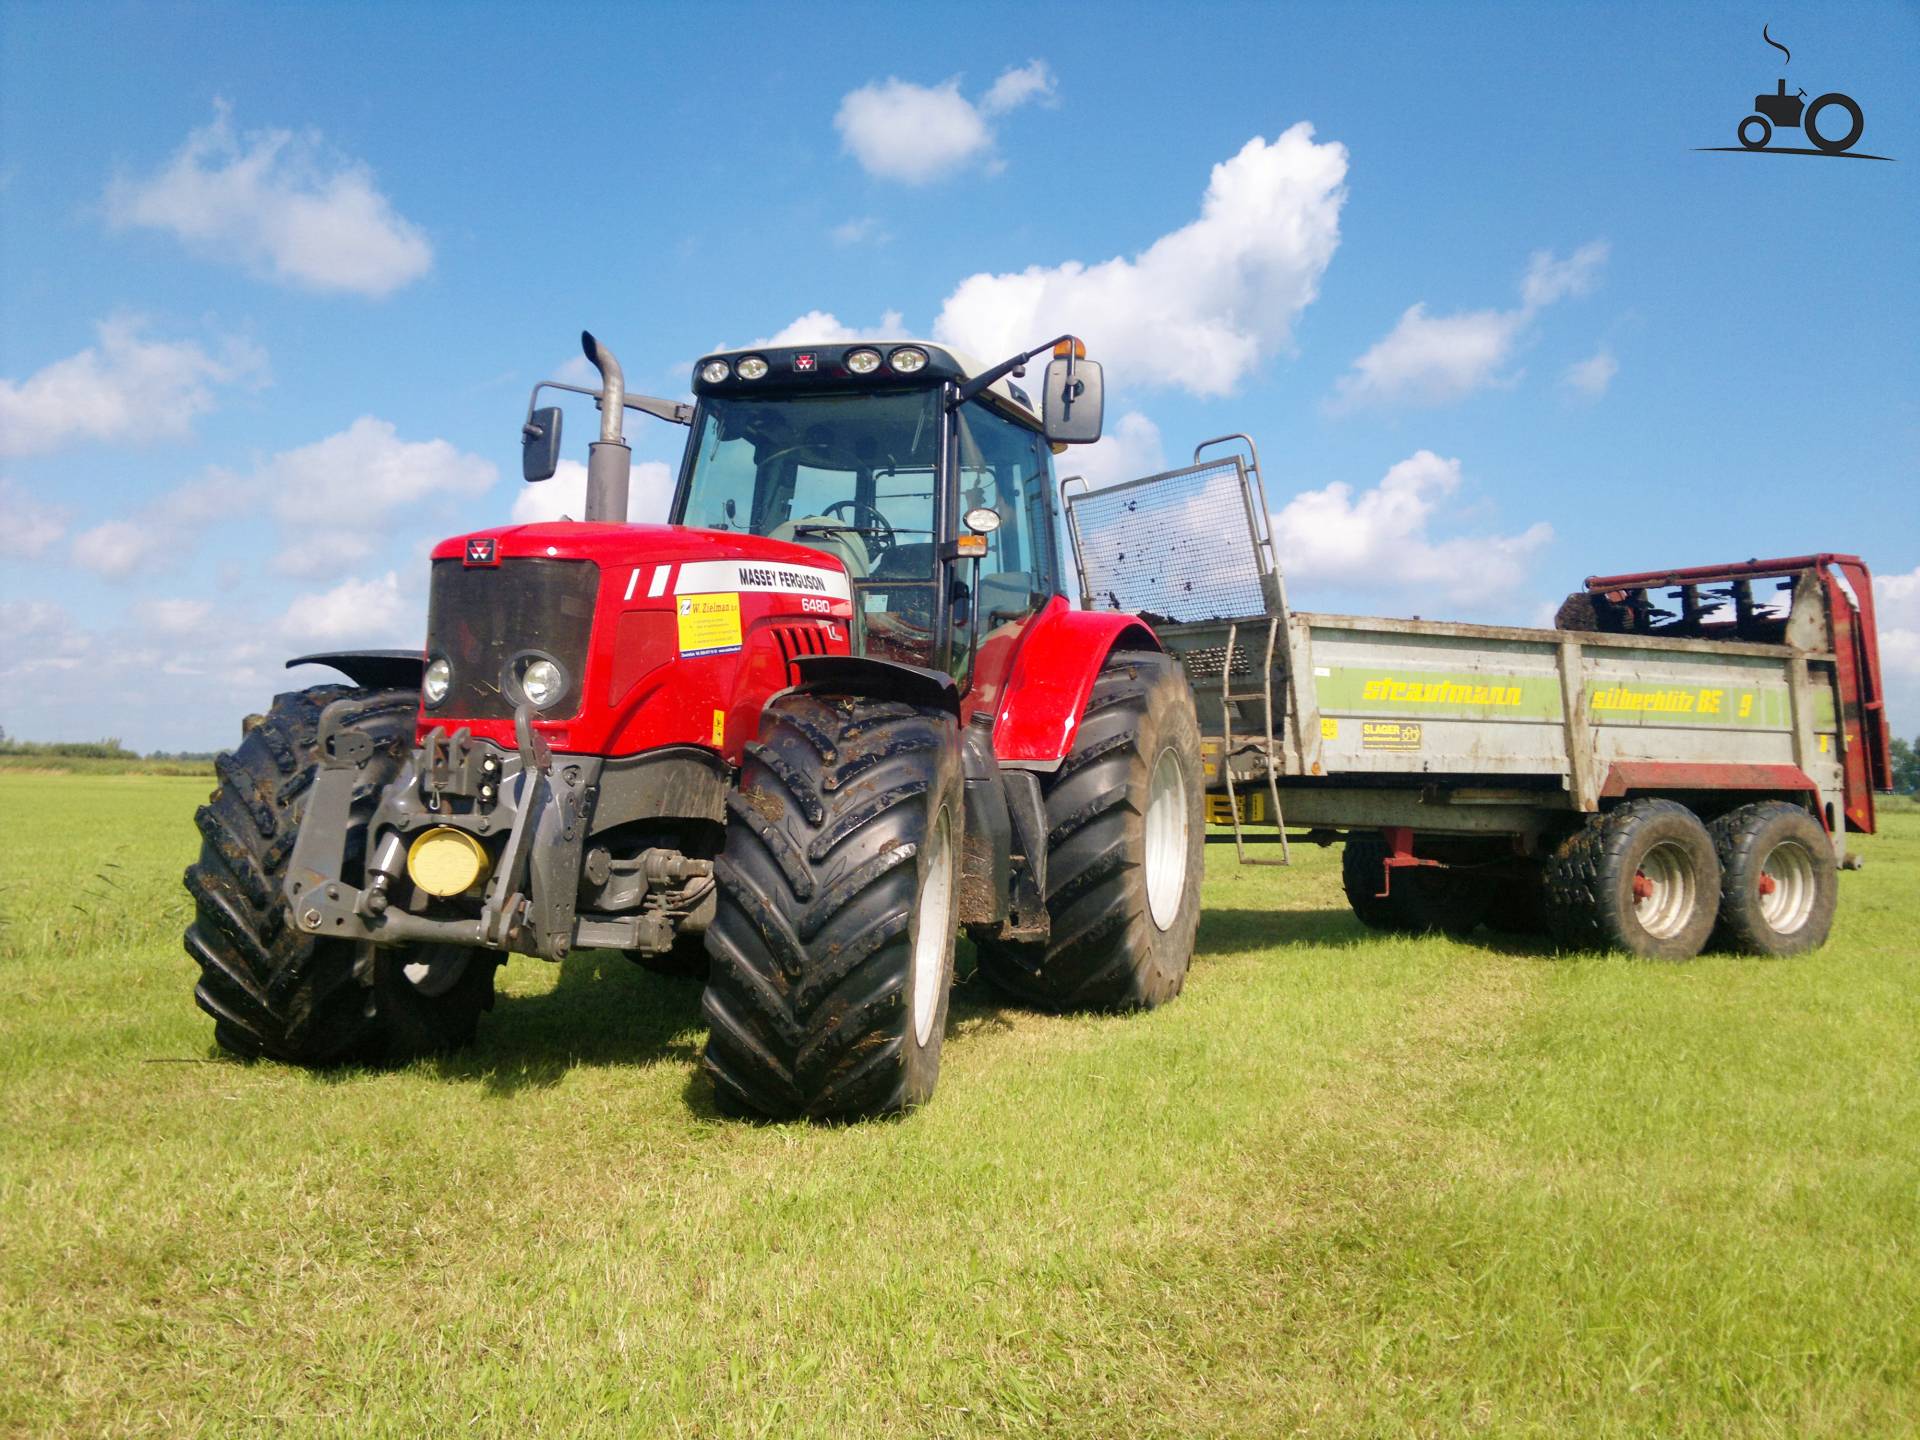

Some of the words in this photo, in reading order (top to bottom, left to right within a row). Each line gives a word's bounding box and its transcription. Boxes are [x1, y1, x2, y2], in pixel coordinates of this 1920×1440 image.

[739, 568, 776, 586] MASSEY
[779, 571, 826, 591] FERGUSON
[702, 602, 729, 613] Zielman
[801, 598, 830, 613] 6480
[1362, 677, 1521, 705] strautmann
[1738, 694, 1753, 718] 9
[1363, 724, 1400, 735] SLAGER
